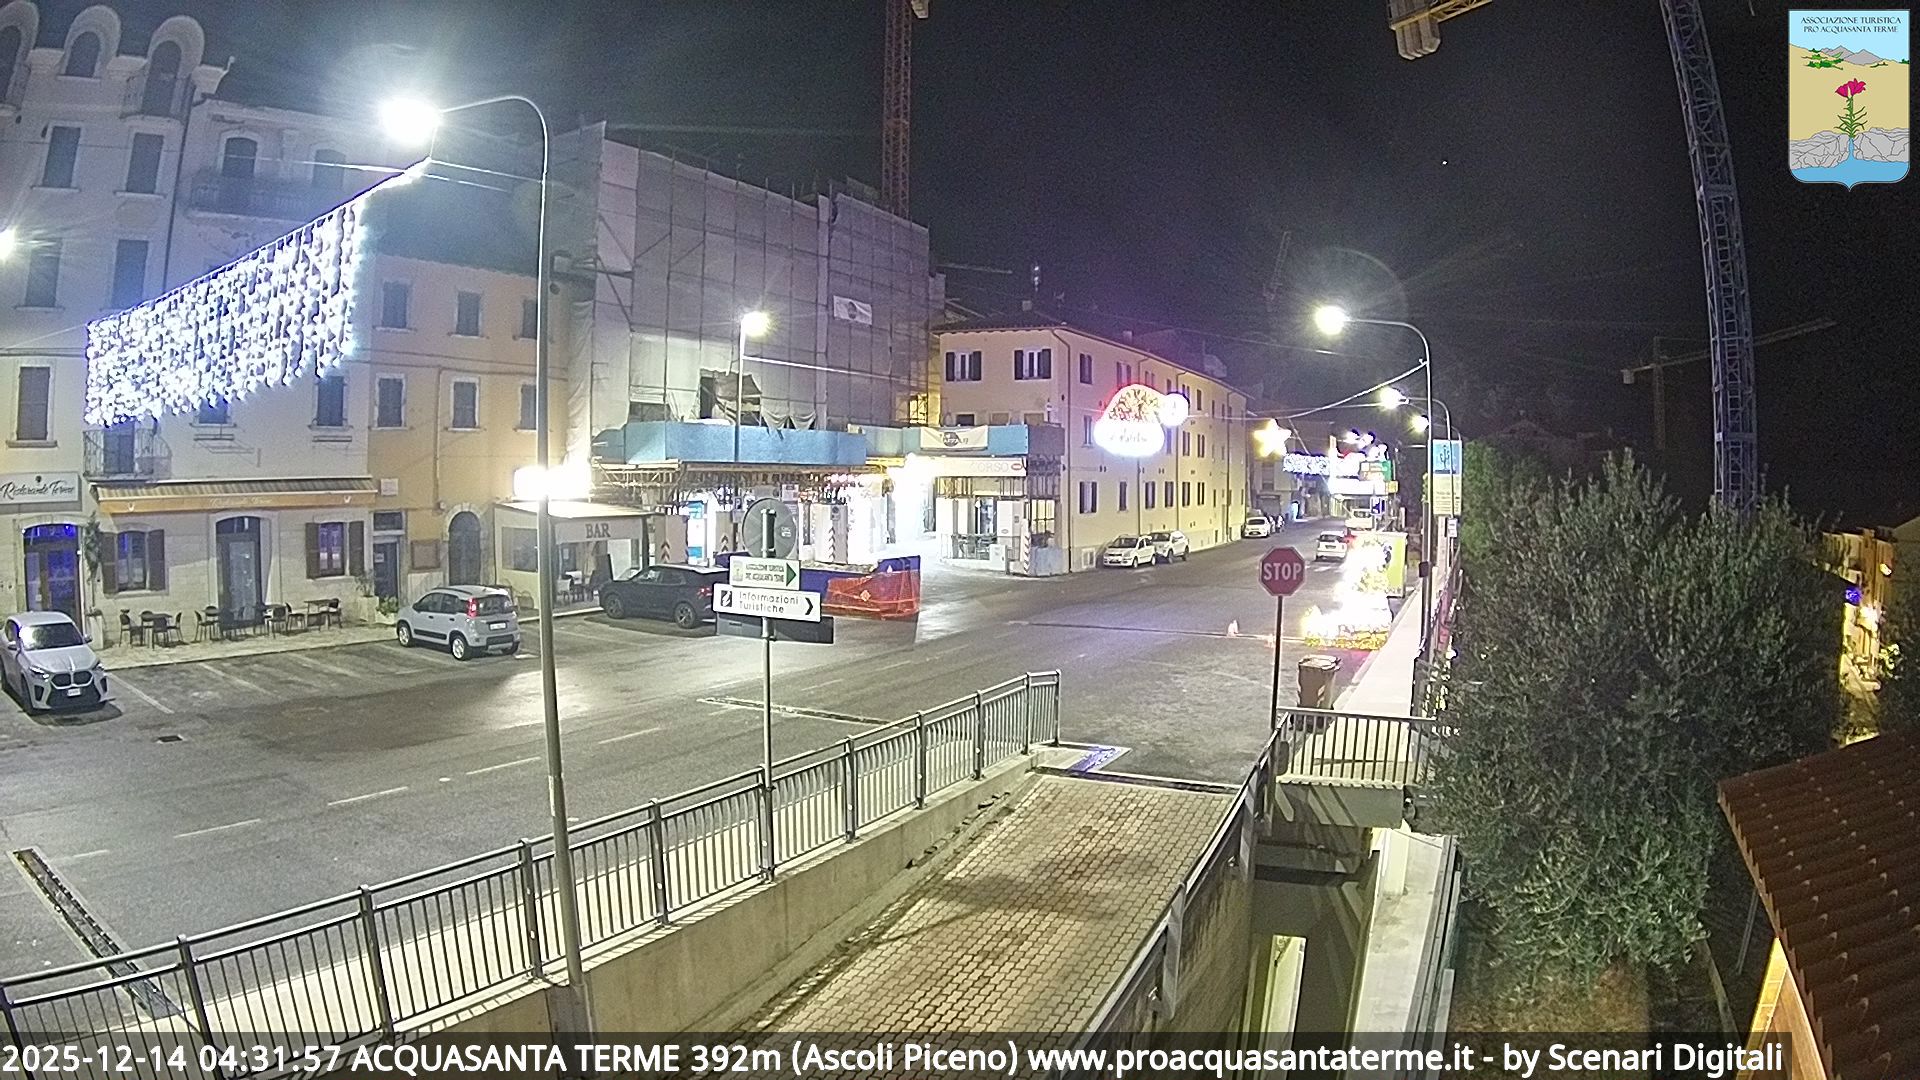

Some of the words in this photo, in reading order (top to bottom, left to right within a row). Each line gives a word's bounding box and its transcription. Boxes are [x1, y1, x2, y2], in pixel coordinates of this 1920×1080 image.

[585, 523, 611, 538] BAR
[1263, 562, 1302, 580] STOP
[739, 591, 799, 604] Informazioni
[739, 600, 784, 613] Turistiche
